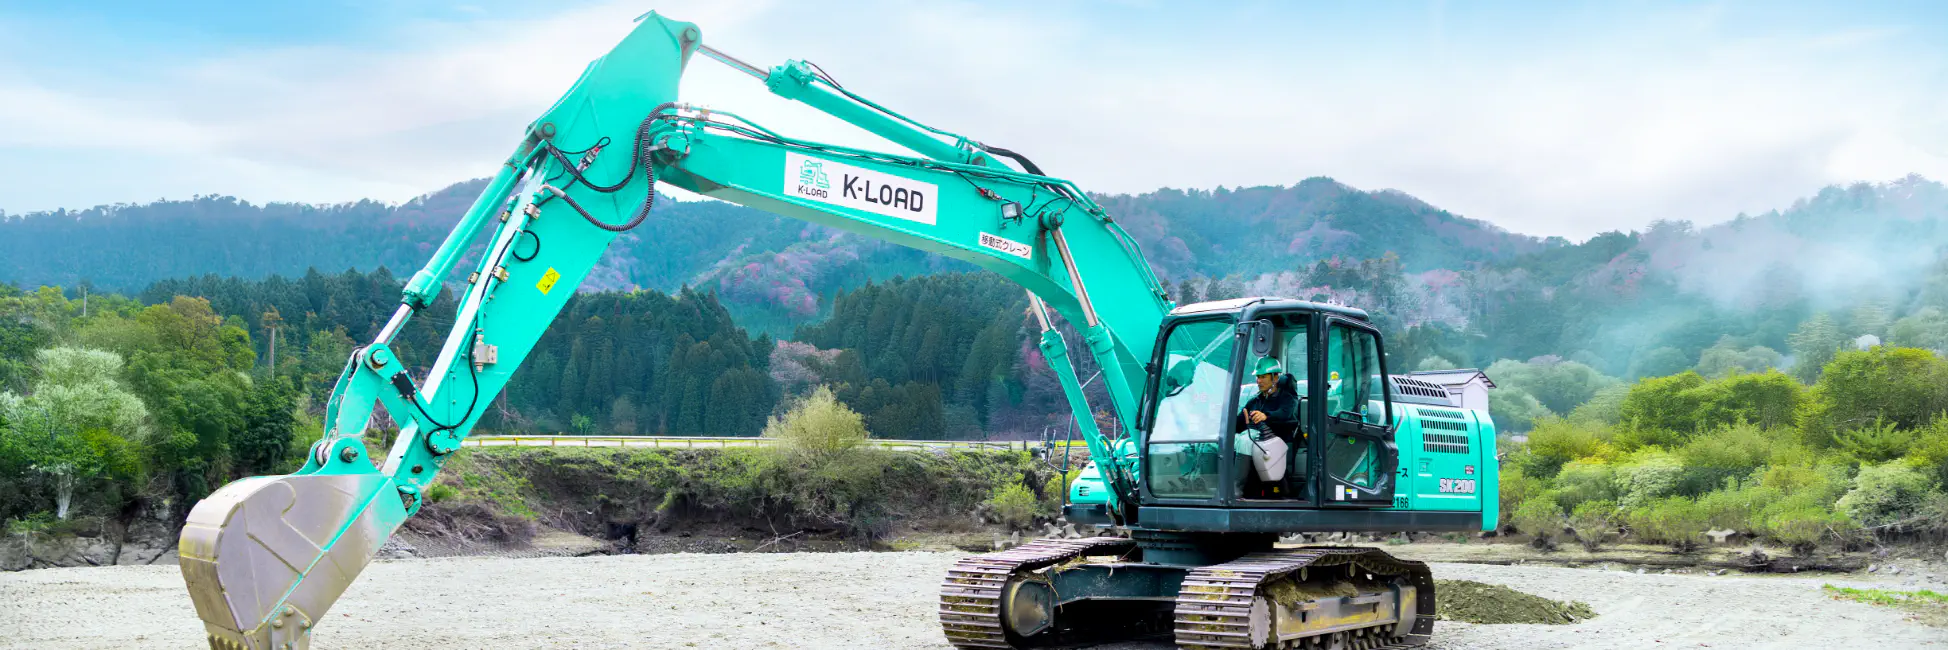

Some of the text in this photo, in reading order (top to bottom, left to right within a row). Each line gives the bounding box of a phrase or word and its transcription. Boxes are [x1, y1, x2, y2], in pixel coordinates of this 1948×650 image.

[797, 184, 828, 199] K-LOAD
[843, 173, 924, 212] K-LOAD
[981, 234, 1030, 256] 移動式クレーン
[1439, 478, 1476, 494] SK200
